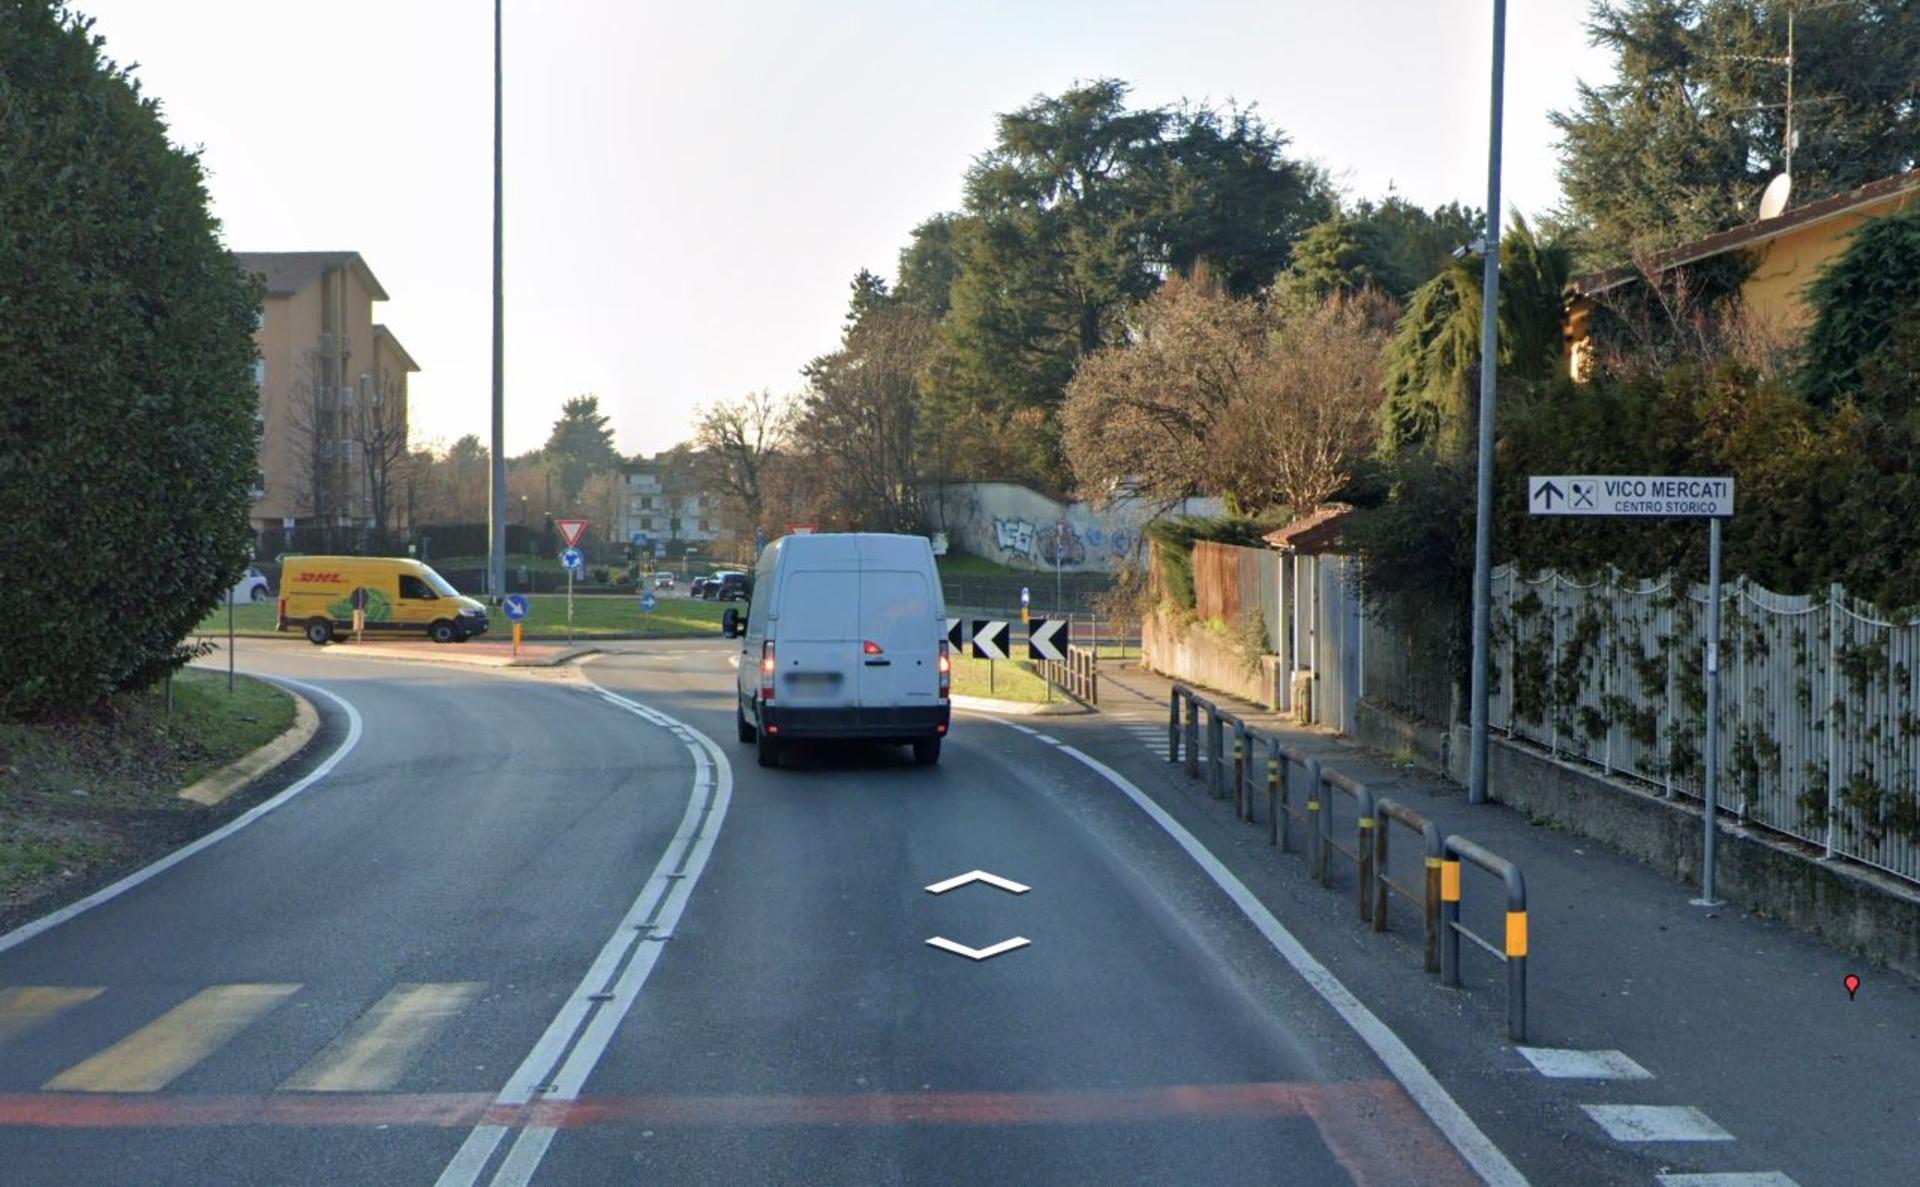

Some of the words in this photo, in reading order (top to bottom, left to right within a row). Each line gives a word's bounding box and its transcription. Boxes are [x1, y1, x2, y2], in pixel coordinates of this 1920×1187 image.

[1604, 481, 1646, 497] VICO
[1652, 481, 1727, 499] MERCATI
[1615, 501, 1662, 513] CENTRO
[1665, 501, 1718, 514] STORICO
[299, 572, 342, 583] DHL
